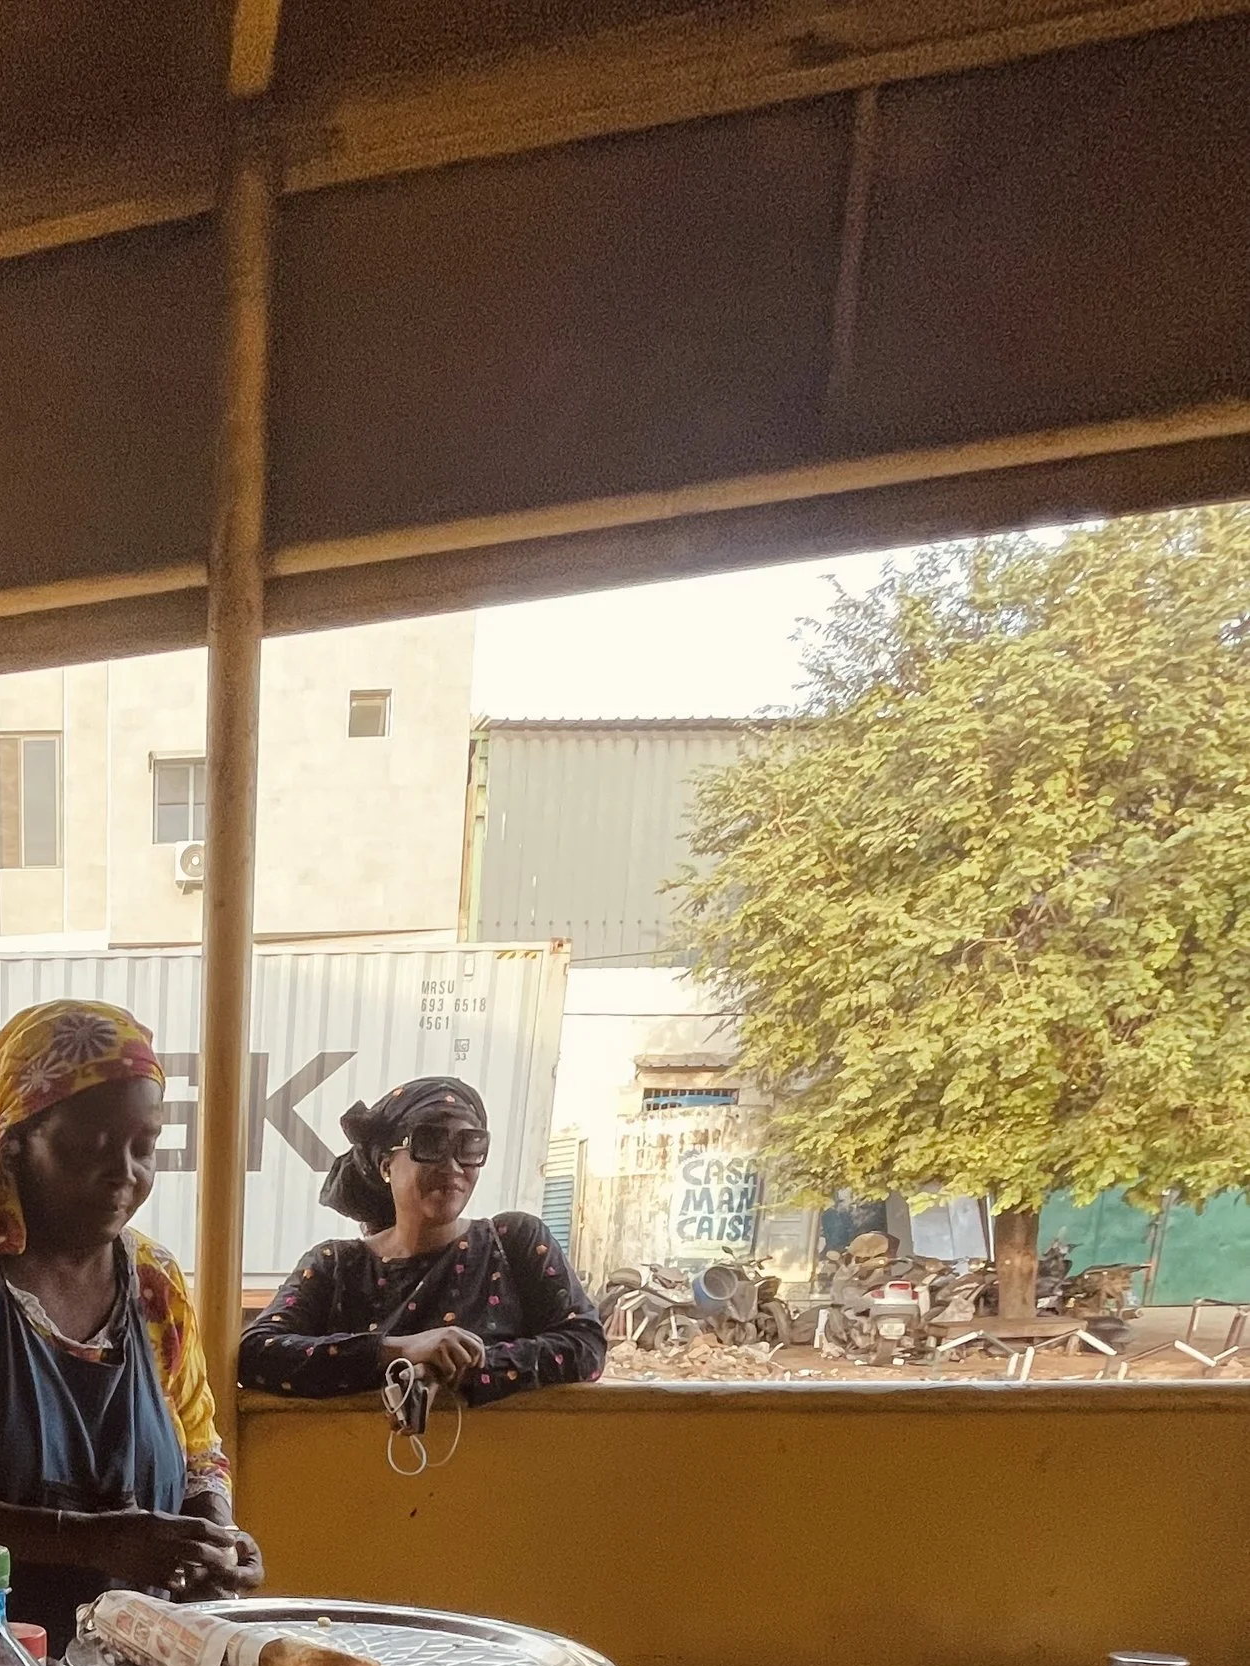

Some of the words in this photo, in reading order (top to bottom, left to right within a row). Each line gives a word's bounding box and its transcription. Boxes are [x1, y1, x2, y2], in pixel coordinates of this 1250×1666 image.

[421, 979, 455, 995] MRSU
[420, 997, 444, 1013] 693
[454, 997, 488, 1013] 6518
[418, 1015, 450, 1031] 45G1
[682, 1157, 759, 1186] CASA
[679, 1186, 757, 1216] MAN
